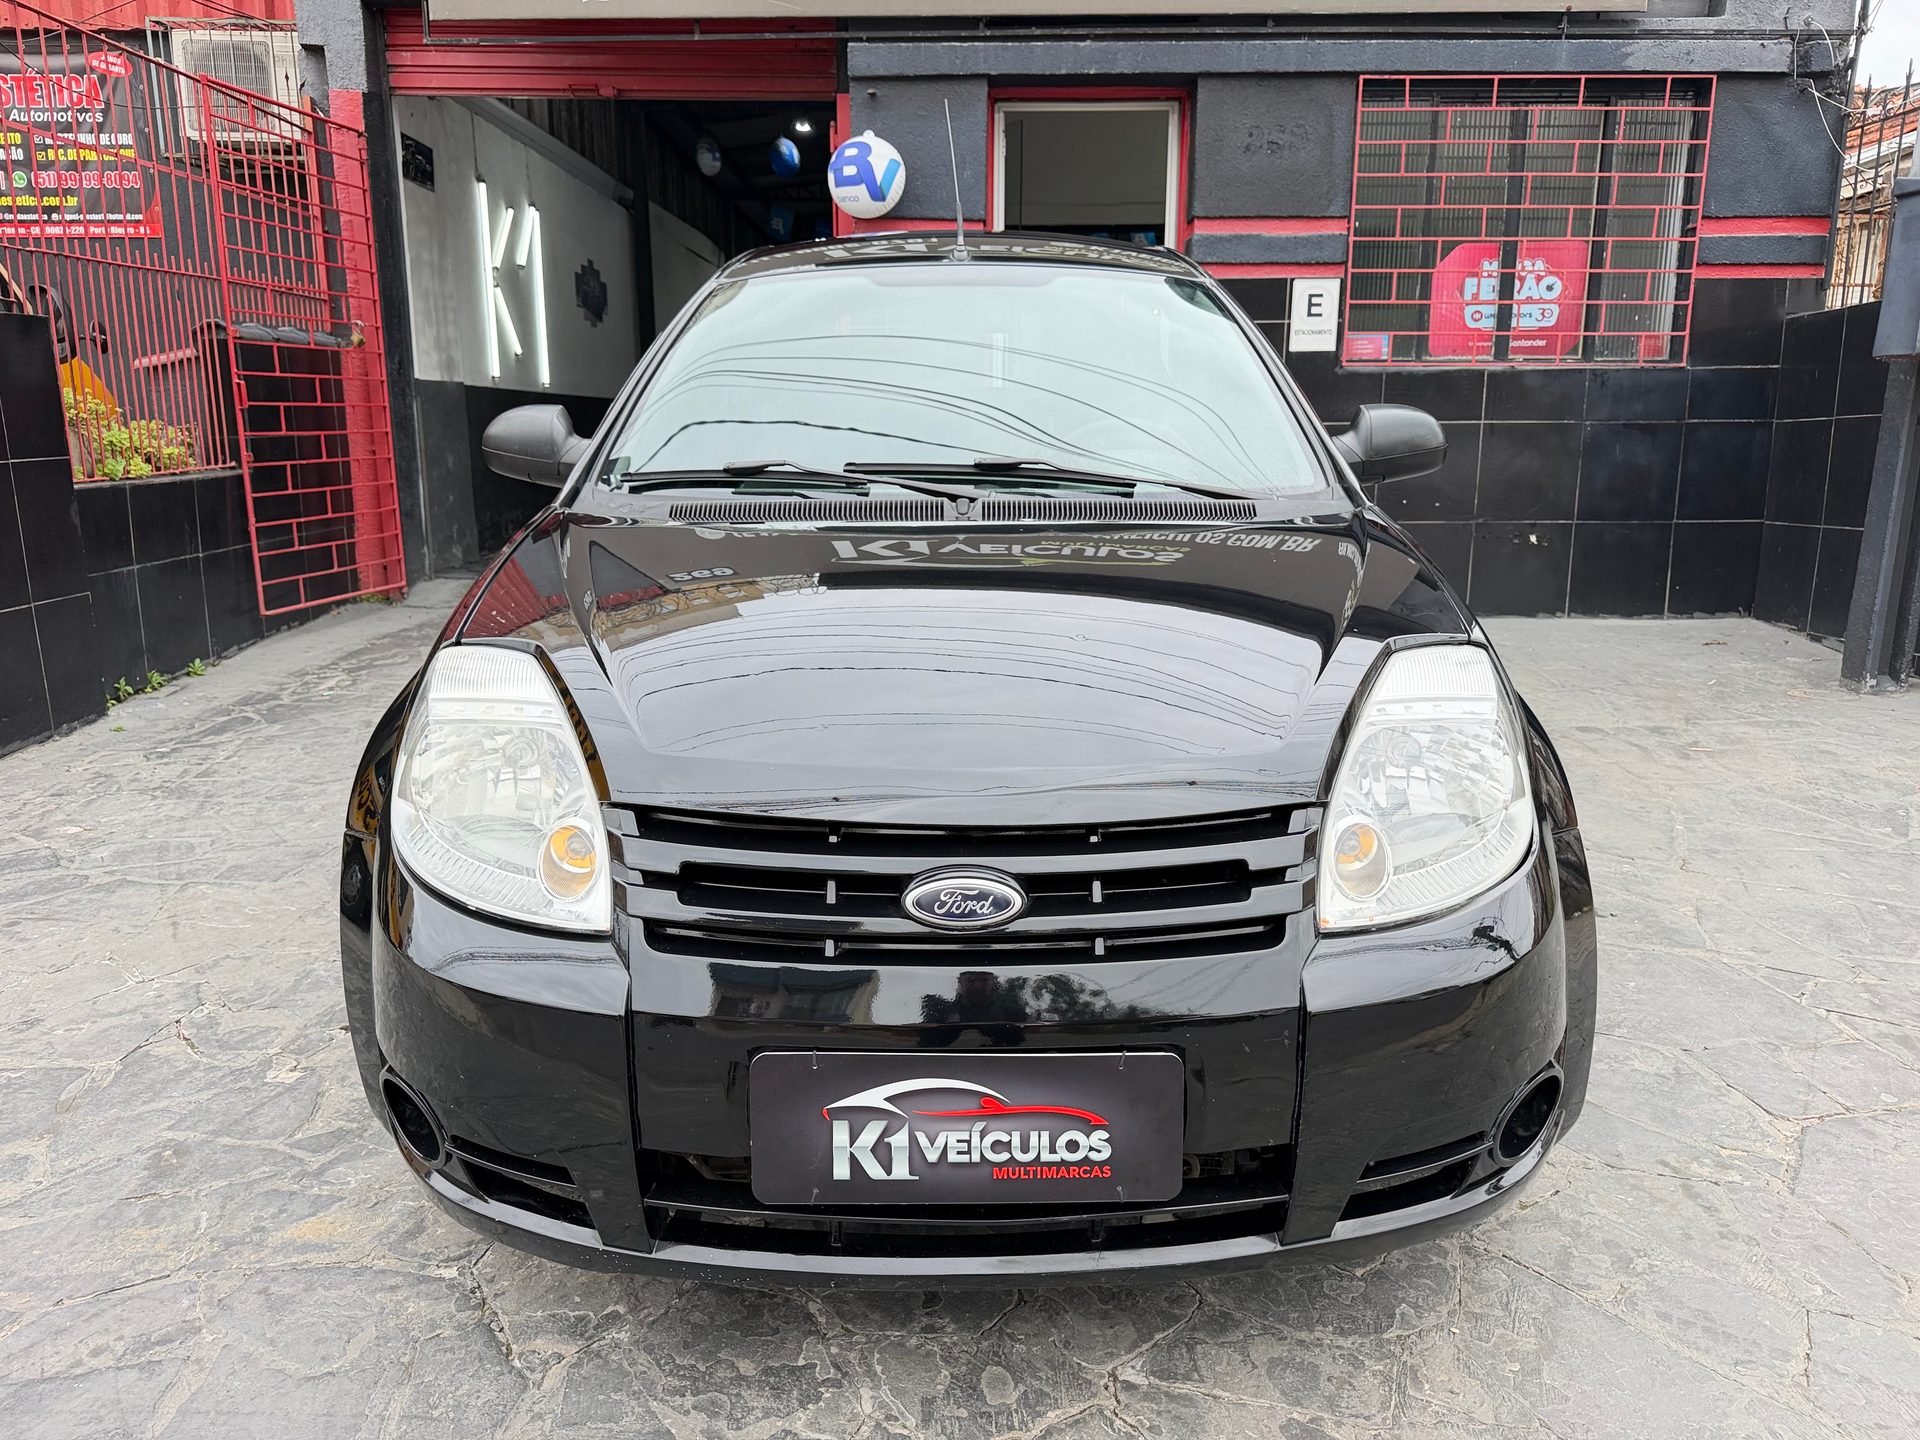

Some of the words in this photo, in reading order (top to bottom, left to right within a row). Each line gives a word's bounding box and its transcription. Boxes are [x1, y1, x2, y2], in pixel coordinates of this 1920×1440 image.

[47, 148, 66, 161] RC.
[80, 148, 136, 162] PARCHOQUE
[60, 170, 140, 188] 9999-8094
[88, 226, 110, 234] Port
[1481, 259, 1546, 276] MGA
[1463, 272, 1562, 301] FEÃO
[1306, 293, 1324, 318] E
[933, 888, 995, 914] Ford
[832, 1119, 920, 1181] K1
[913, 1120, 1113, 1164] VEÍCULOS
[992, 1165, 1112, 1179] MULTIMARCAS
